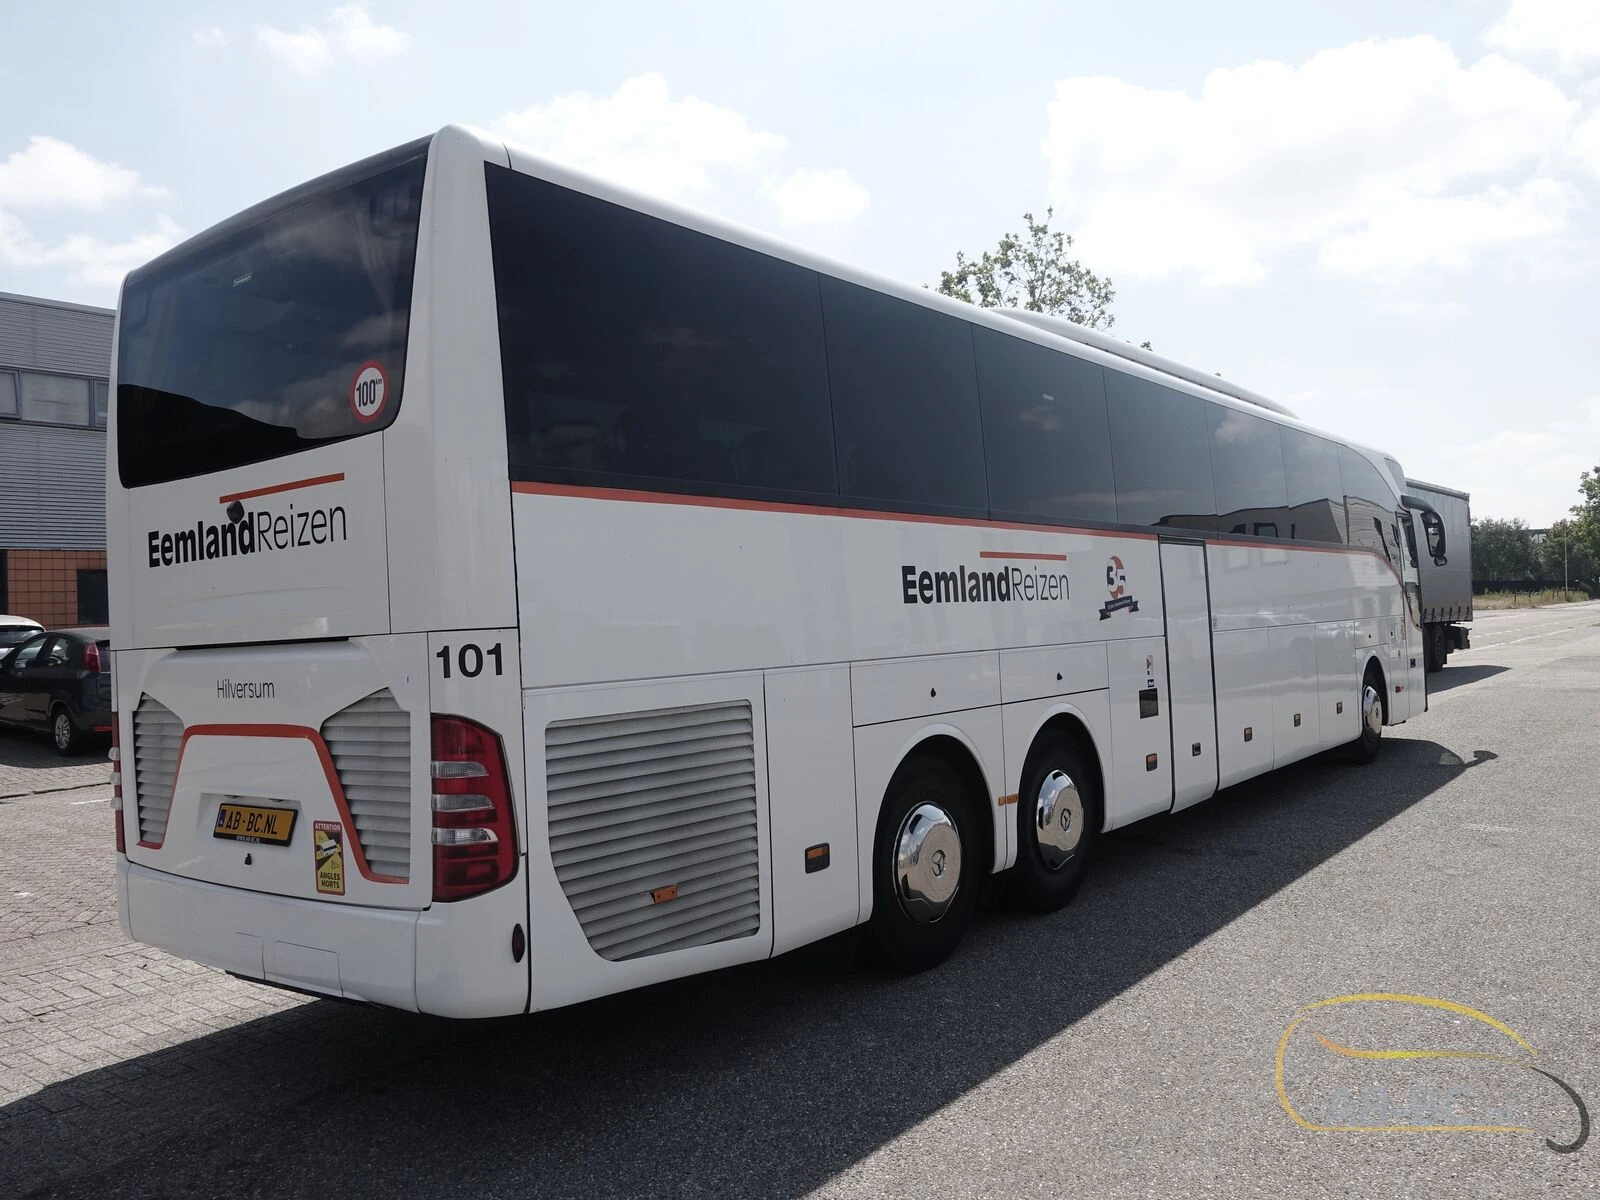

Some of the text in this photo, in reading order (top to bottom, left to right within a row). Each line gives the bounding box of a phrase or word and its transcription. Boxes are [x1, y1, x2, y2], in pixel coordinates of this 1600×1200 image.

[148, 503, 347, 568] EemlandReizen
[901, 565, 1070, 604] EemlandReizen
[436, 643, 502, 678] 101
[216, 678, 275, 699] Hilversum
[315, 823, 341, 831] ATTENTION
[320, 872, 341, 881] ANGLES
[321, 880, 340, 889] MORTS
